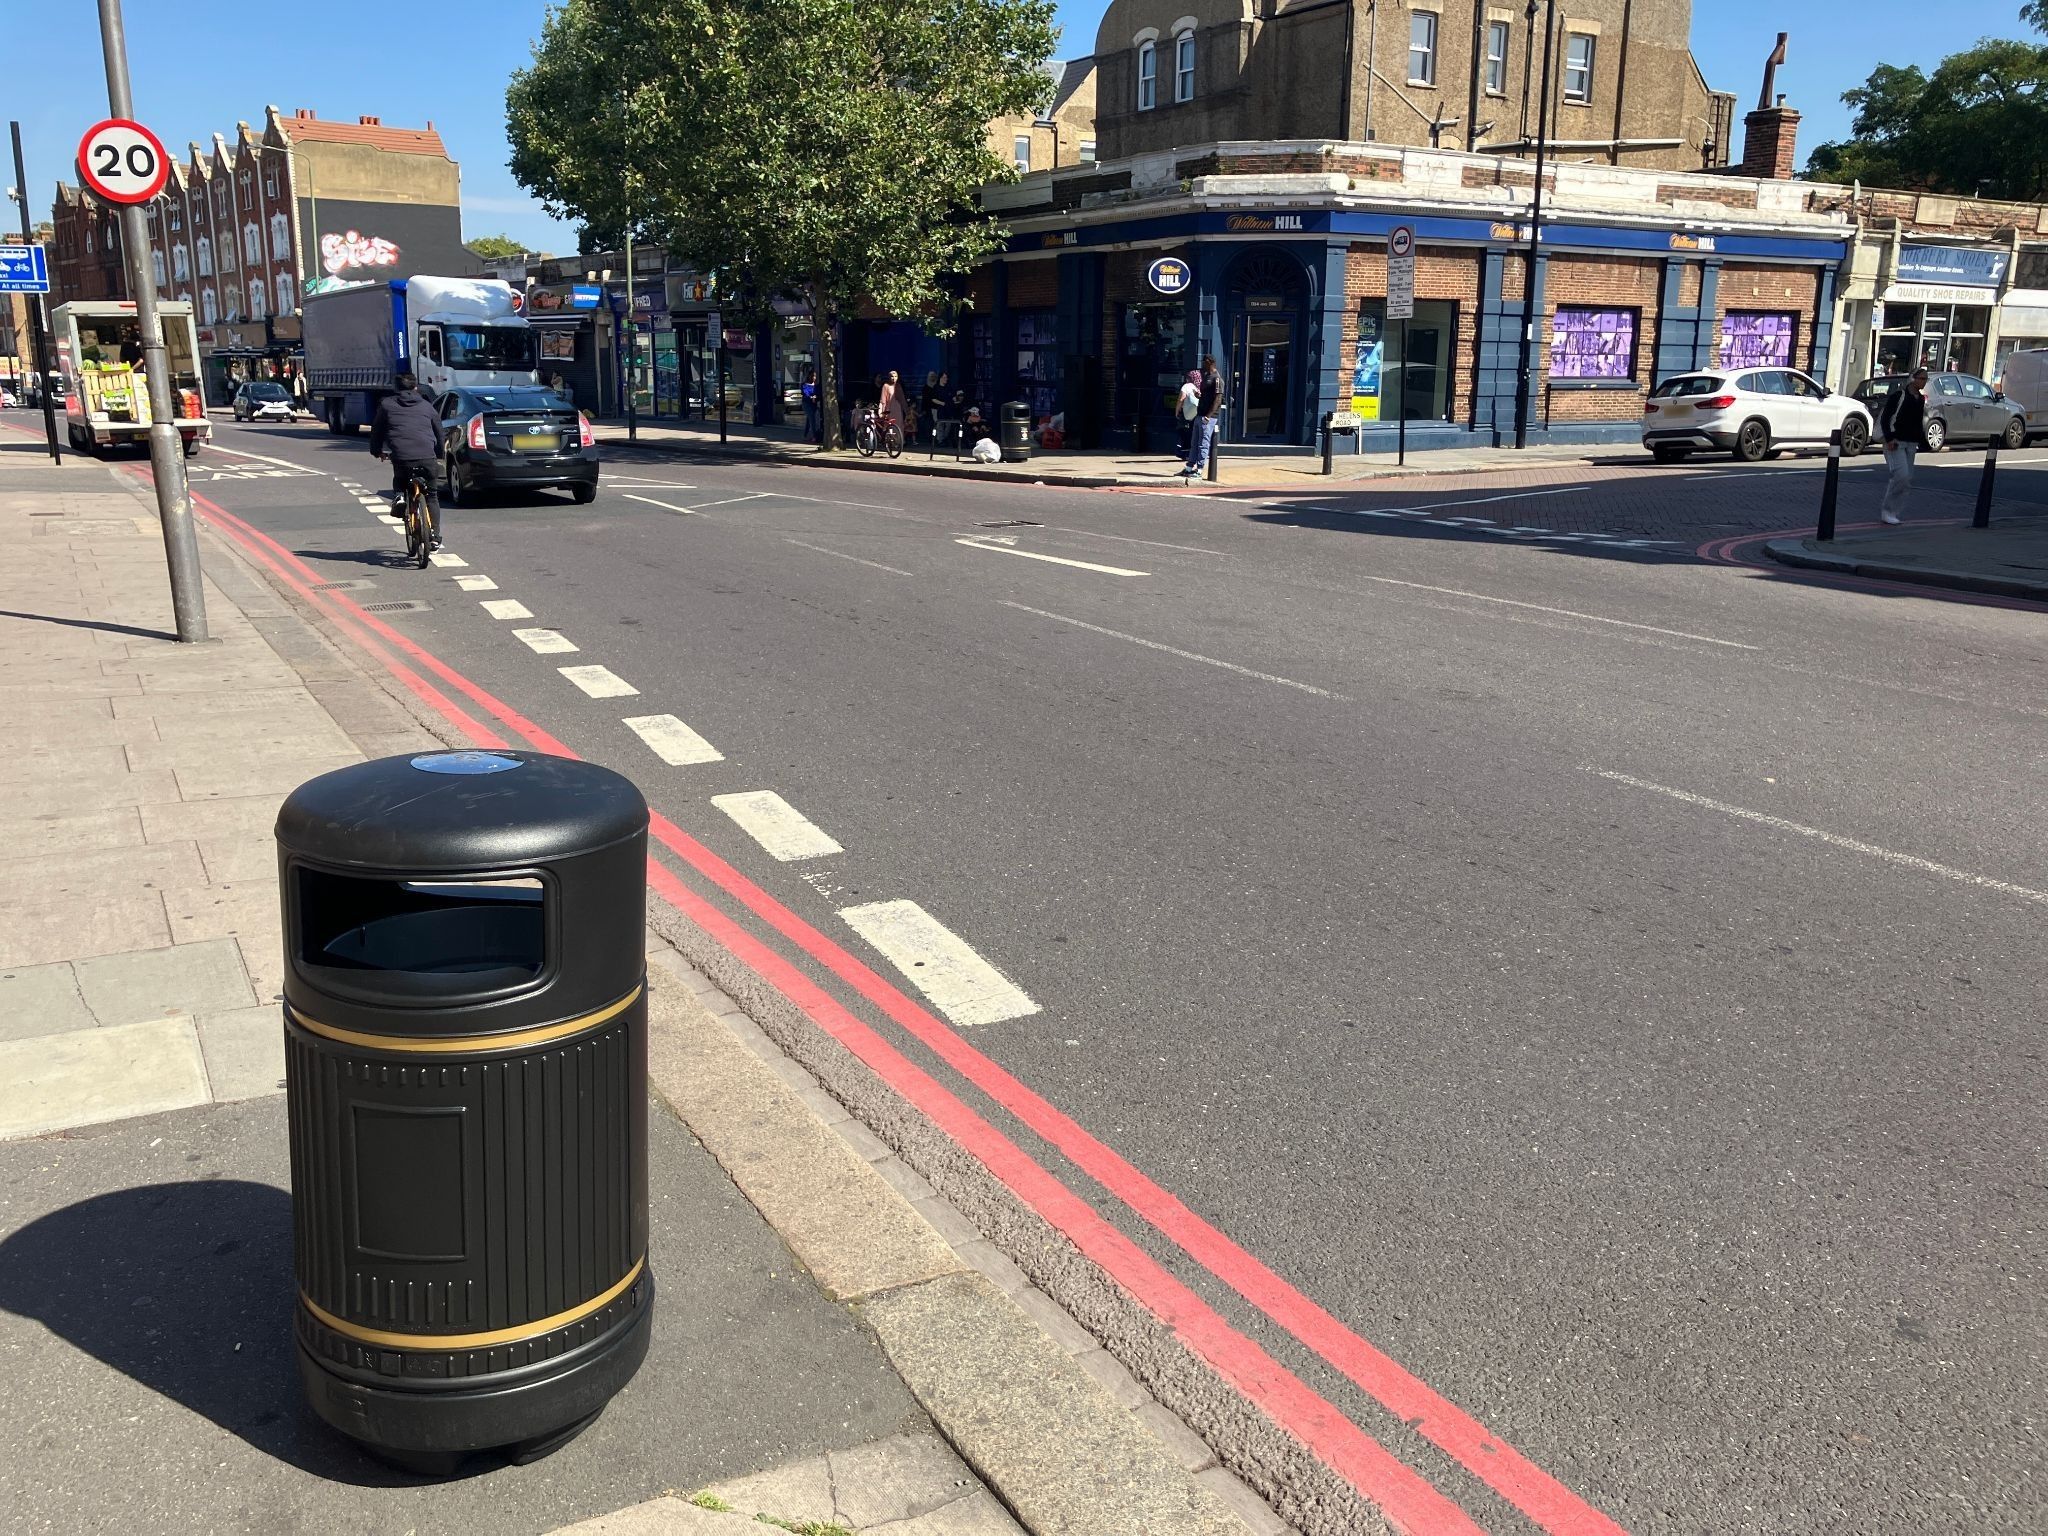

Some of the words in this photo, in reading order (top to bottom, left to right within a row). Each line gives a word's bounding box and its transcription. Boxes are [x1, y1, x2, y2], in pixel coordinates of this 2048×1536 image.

[94, 144, 155, 177] 20
[1275, 216, 1302, 230] HILL
[1063, 232, 1077, 245] HILL
[1522, 227, 1542, 241] HIL
[1698, 237, 1715, 250] HILL
[1159, 274, 1180, 287] HILL
[1897, 287, 1931, 297] QUALITY
[1933, 289, 1953, 299] SHOE
[1956, 290, 1986, 300] REPAIRS
[1358, 317, 1376, 326] EPIC
[1339, 412, 1361, 420] HELENS
